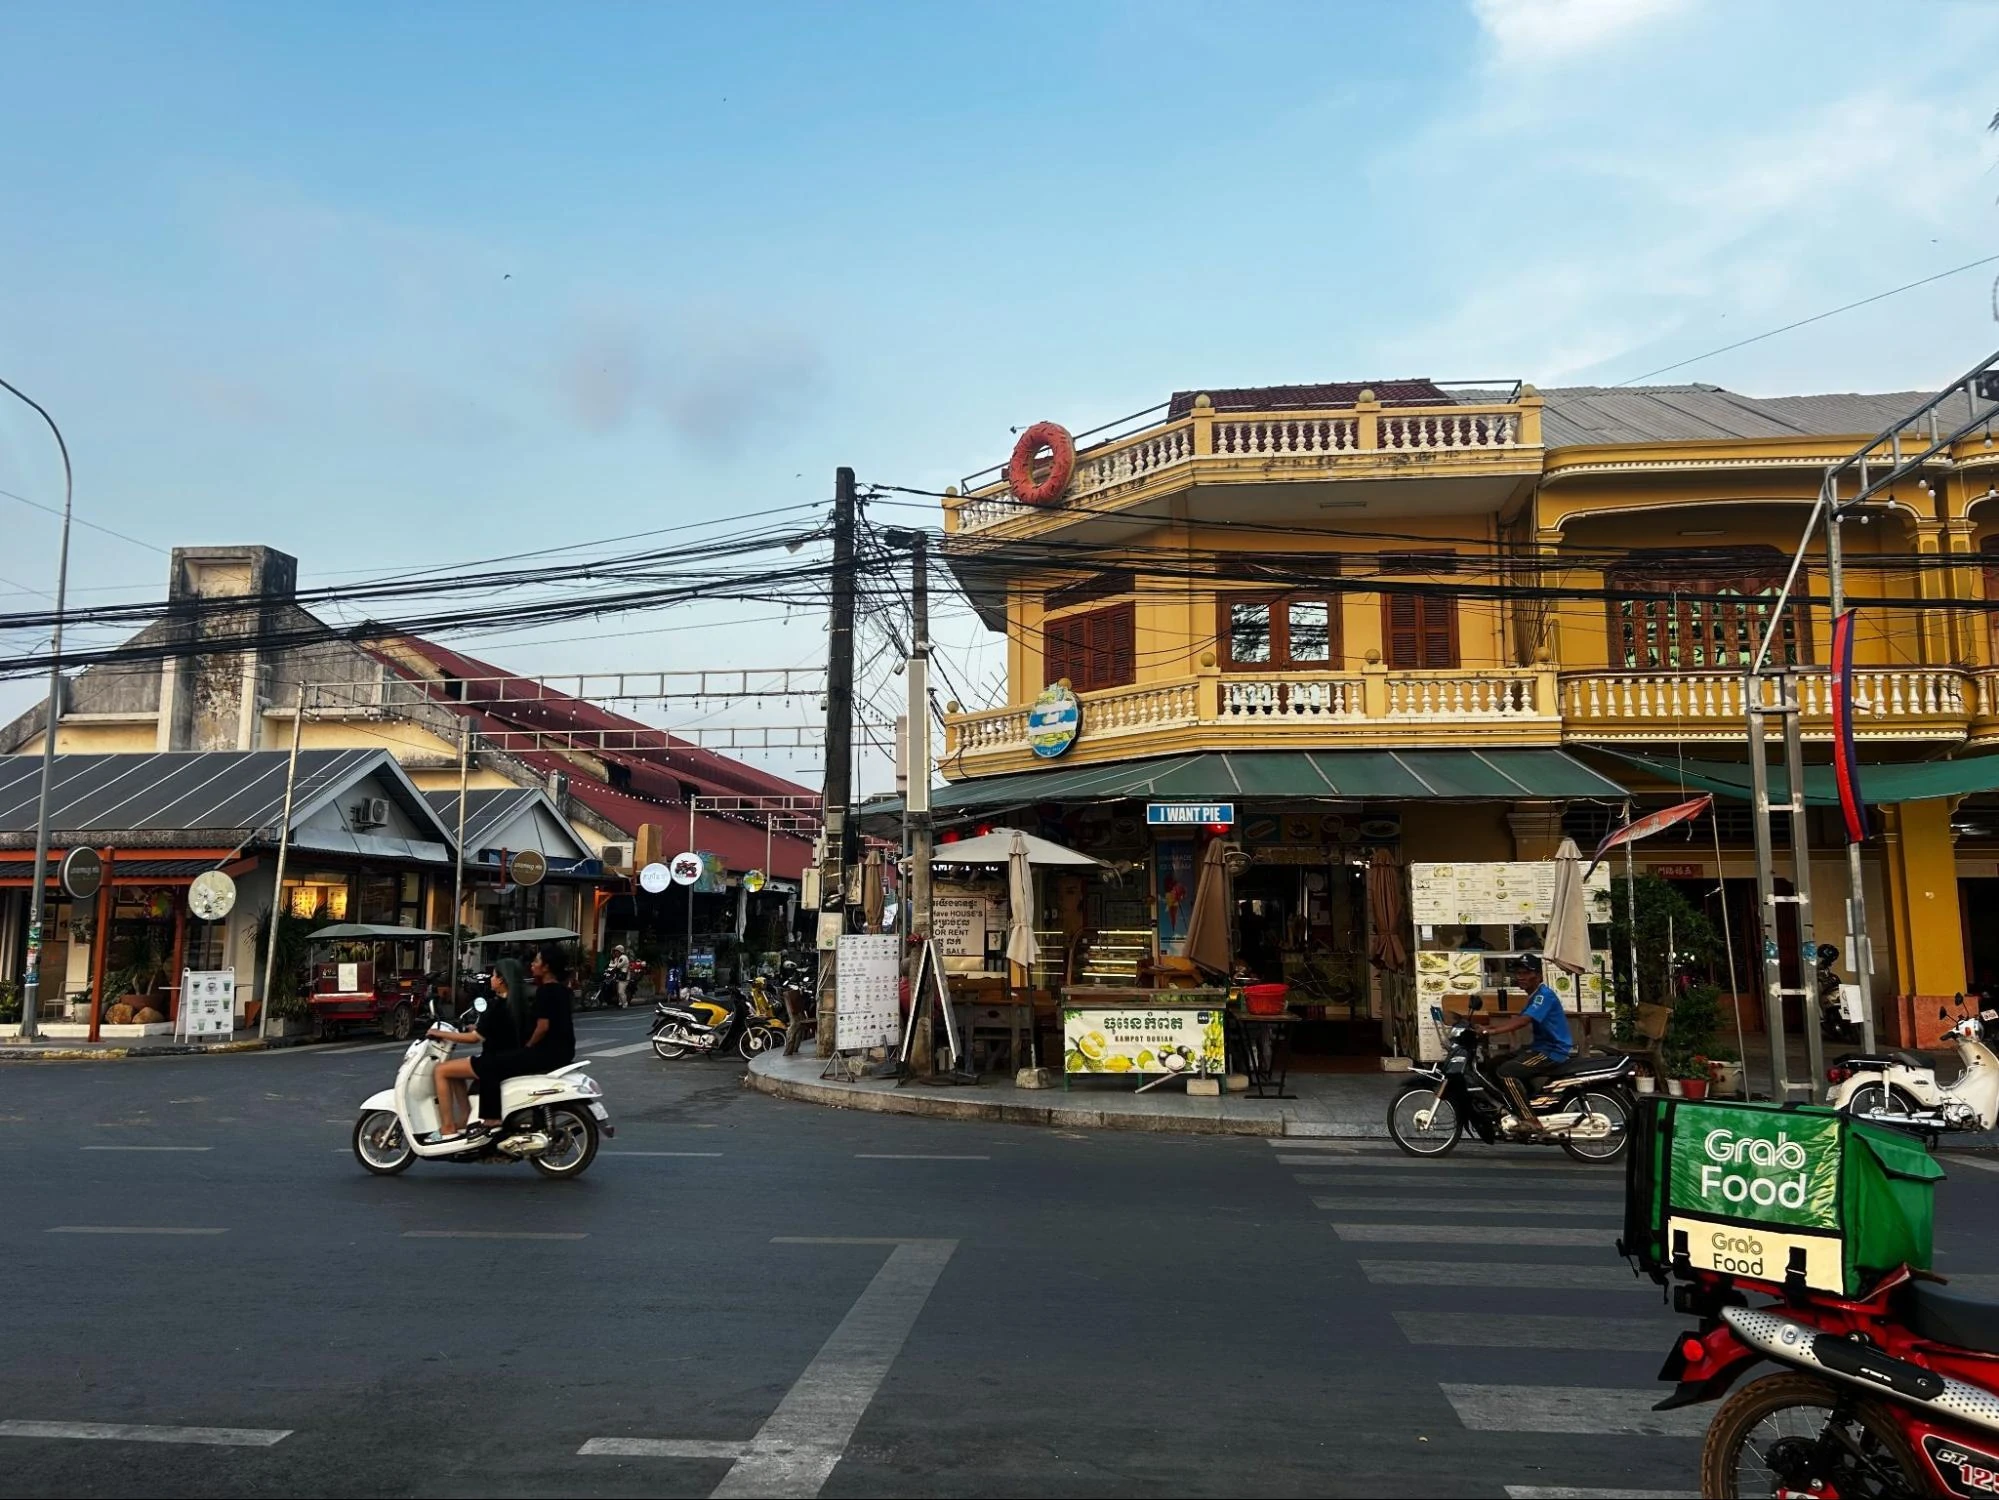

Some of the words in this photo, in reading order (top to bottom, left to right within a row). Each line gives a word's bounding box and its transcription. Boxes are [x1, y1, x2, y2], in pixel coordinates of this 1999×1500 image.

[1160, 807, 1165, 821] I
[1166, 807, 1200, 821] WANT
[1202, 807, 1221, 821] PIE
[1704, 1128, 1806, 1170] Grab
[1701, 1165, 1807, 1209] Food
[1711, 1232, 1764, 1256] Grab
[1713, 1253, 1764, 1276] Food
[1936, 1448, 1968, 1466] CT
